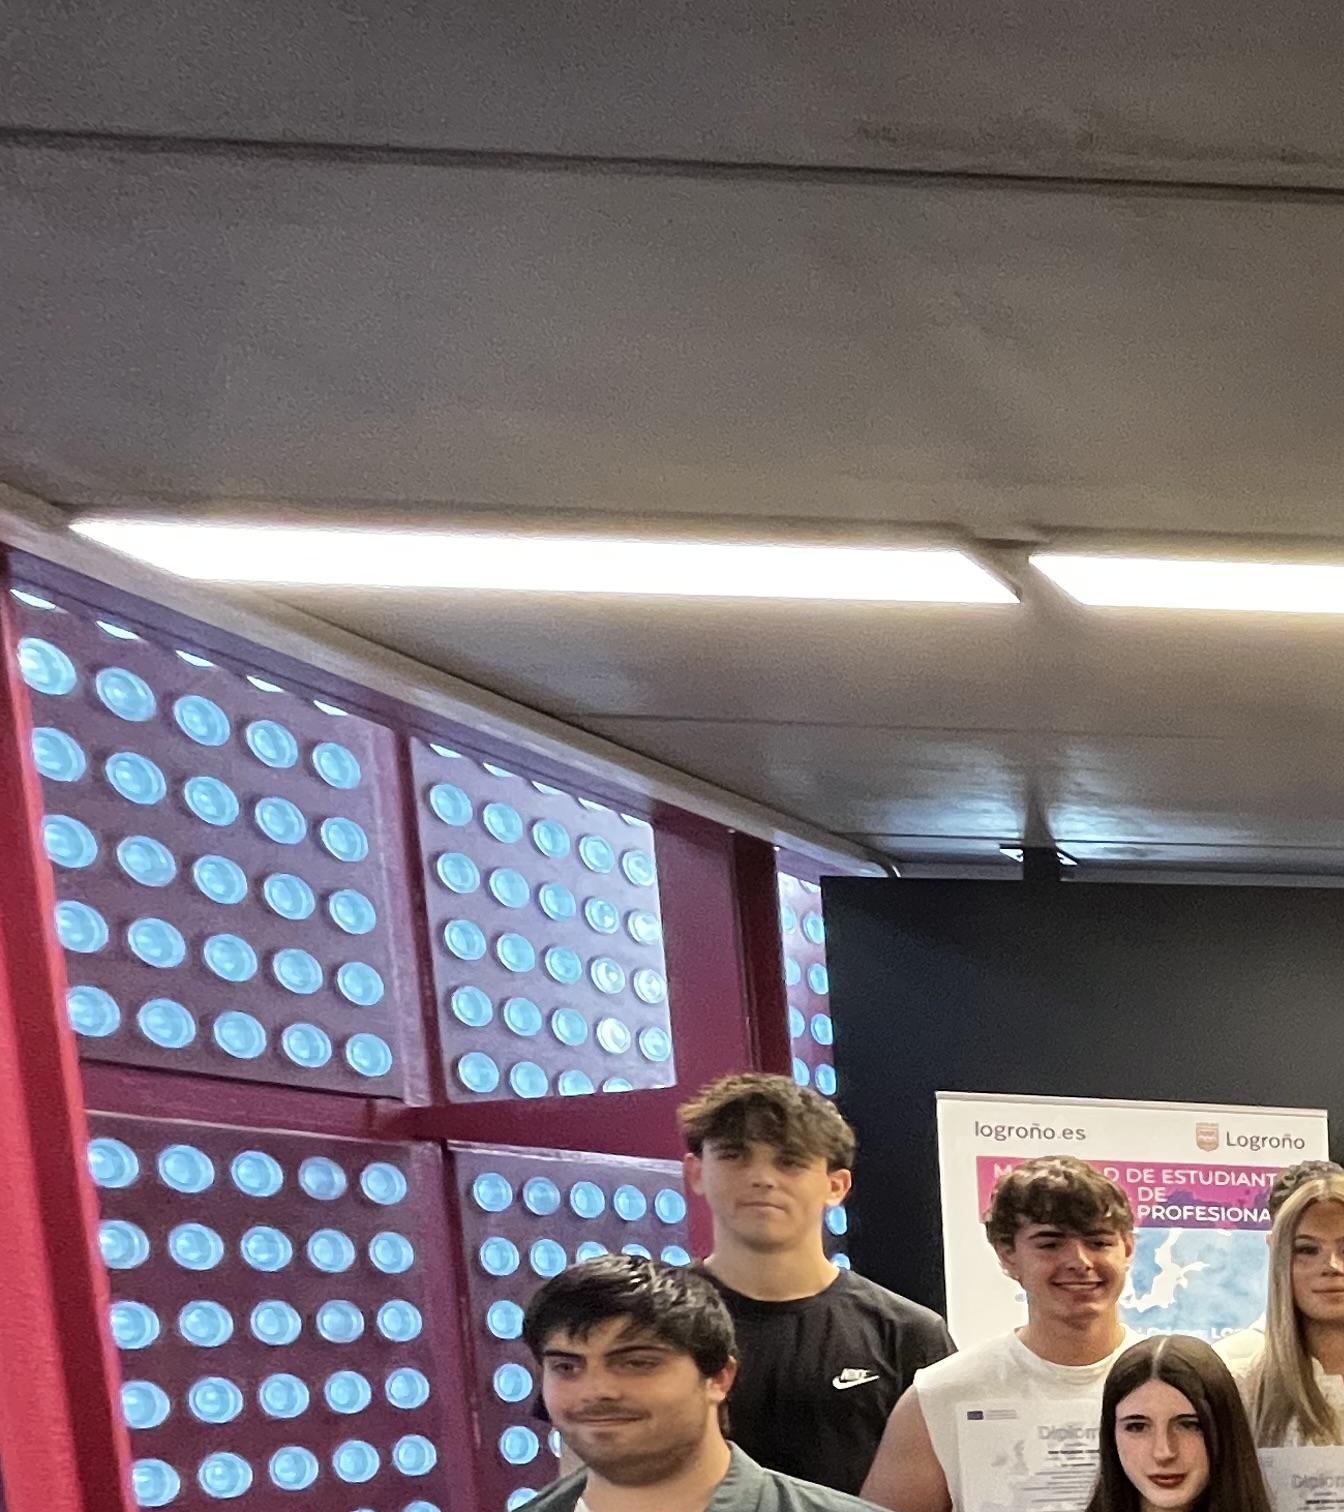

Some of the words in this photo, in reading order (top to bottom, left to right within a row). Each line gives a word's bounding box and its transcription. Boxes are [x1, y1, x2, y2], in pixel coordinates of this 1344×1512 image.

[975, 1121, 1086, 1141] logroño.es
[1227, 1131, 1305, 1151] Logroño
[1126, 1168, 1155, 1184] DE
[1162, 1169, 1277, 1187] ESTUDIANT
[1137, 1187, 1167, 1202] DE
[1137, 1205, 1271, 1223] PROFESIONA
